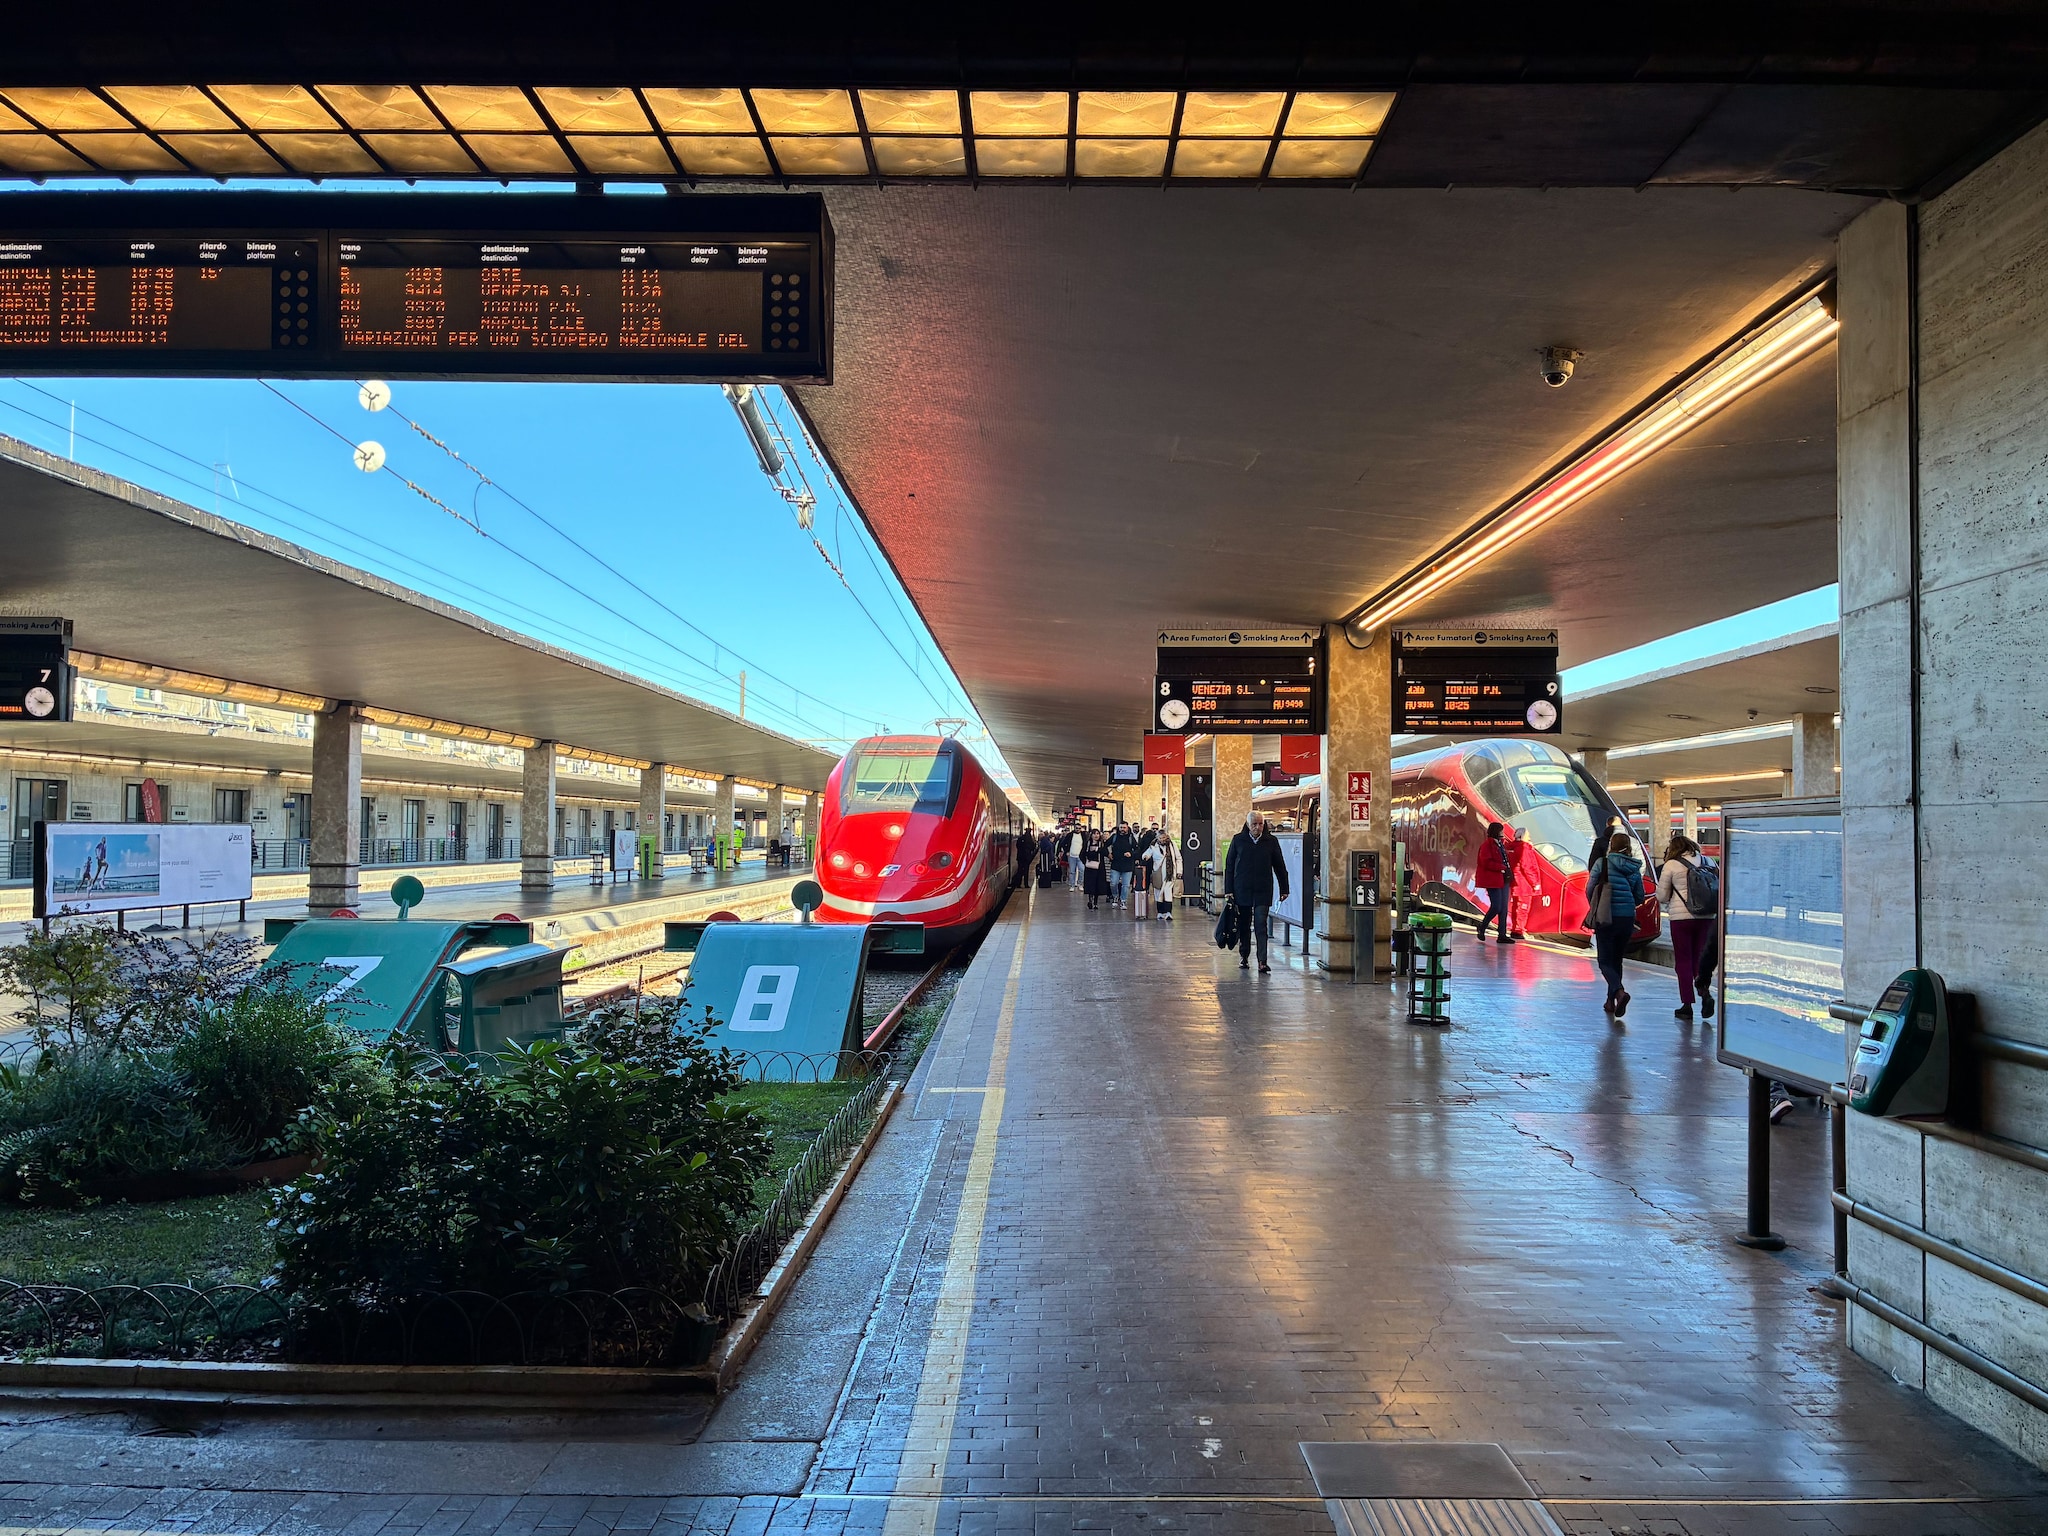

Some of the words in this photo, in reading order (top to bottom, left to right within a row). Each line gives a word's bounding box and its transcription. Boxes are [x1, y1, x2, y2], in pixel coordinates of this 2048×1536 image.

[0, 243, 43, 251] estinazione
[199, 242, 227, 250] ritardo
[247, 242, 276, 250] binario
[340, 244, 361, 252] treno
[481, 245, 529, 253] destinazione
[620, 246, 646, 254] orario
[690, 247, 718, 255] ritardo
[738, 247, 768, 255] binario
[0, 252, 31, 260] estination
[199, 252, 218, 260] delay
[246, 252, 276, 260] platform
[738, 257, 767, 265] platform
[481, 267, 521, 282] ORTE
[344, 331, 438, 346] VARIAZIONI
[448, 331, 479, 346] PER
[489, 332, 520, 346] UNO
[531, 332, 609, 347] SCIOPERO
[619, 332, 708, 347] NAZIONALE
[718, 333, 748, 348] DEL
[1243, 635, 1278, 643] Smoking
[1489, 635, 1524, 643] Smoking
[40, 669, 51, 683] 7
[1160, 681, 1171, 696] 8
[1192, 684, 1231, 695] VENEZIA
[1445, 685, 1479, 695] TORINO
[1546, 681, 1558, 696] 9
[1444, 700, 1470, 710] 10:25
[1186, 831, 1201, 850] 8
[1541, 895, 1550, 907] 10
[304, 956, 384, 1010] 7
[728, 965, 800, 1032] 8
